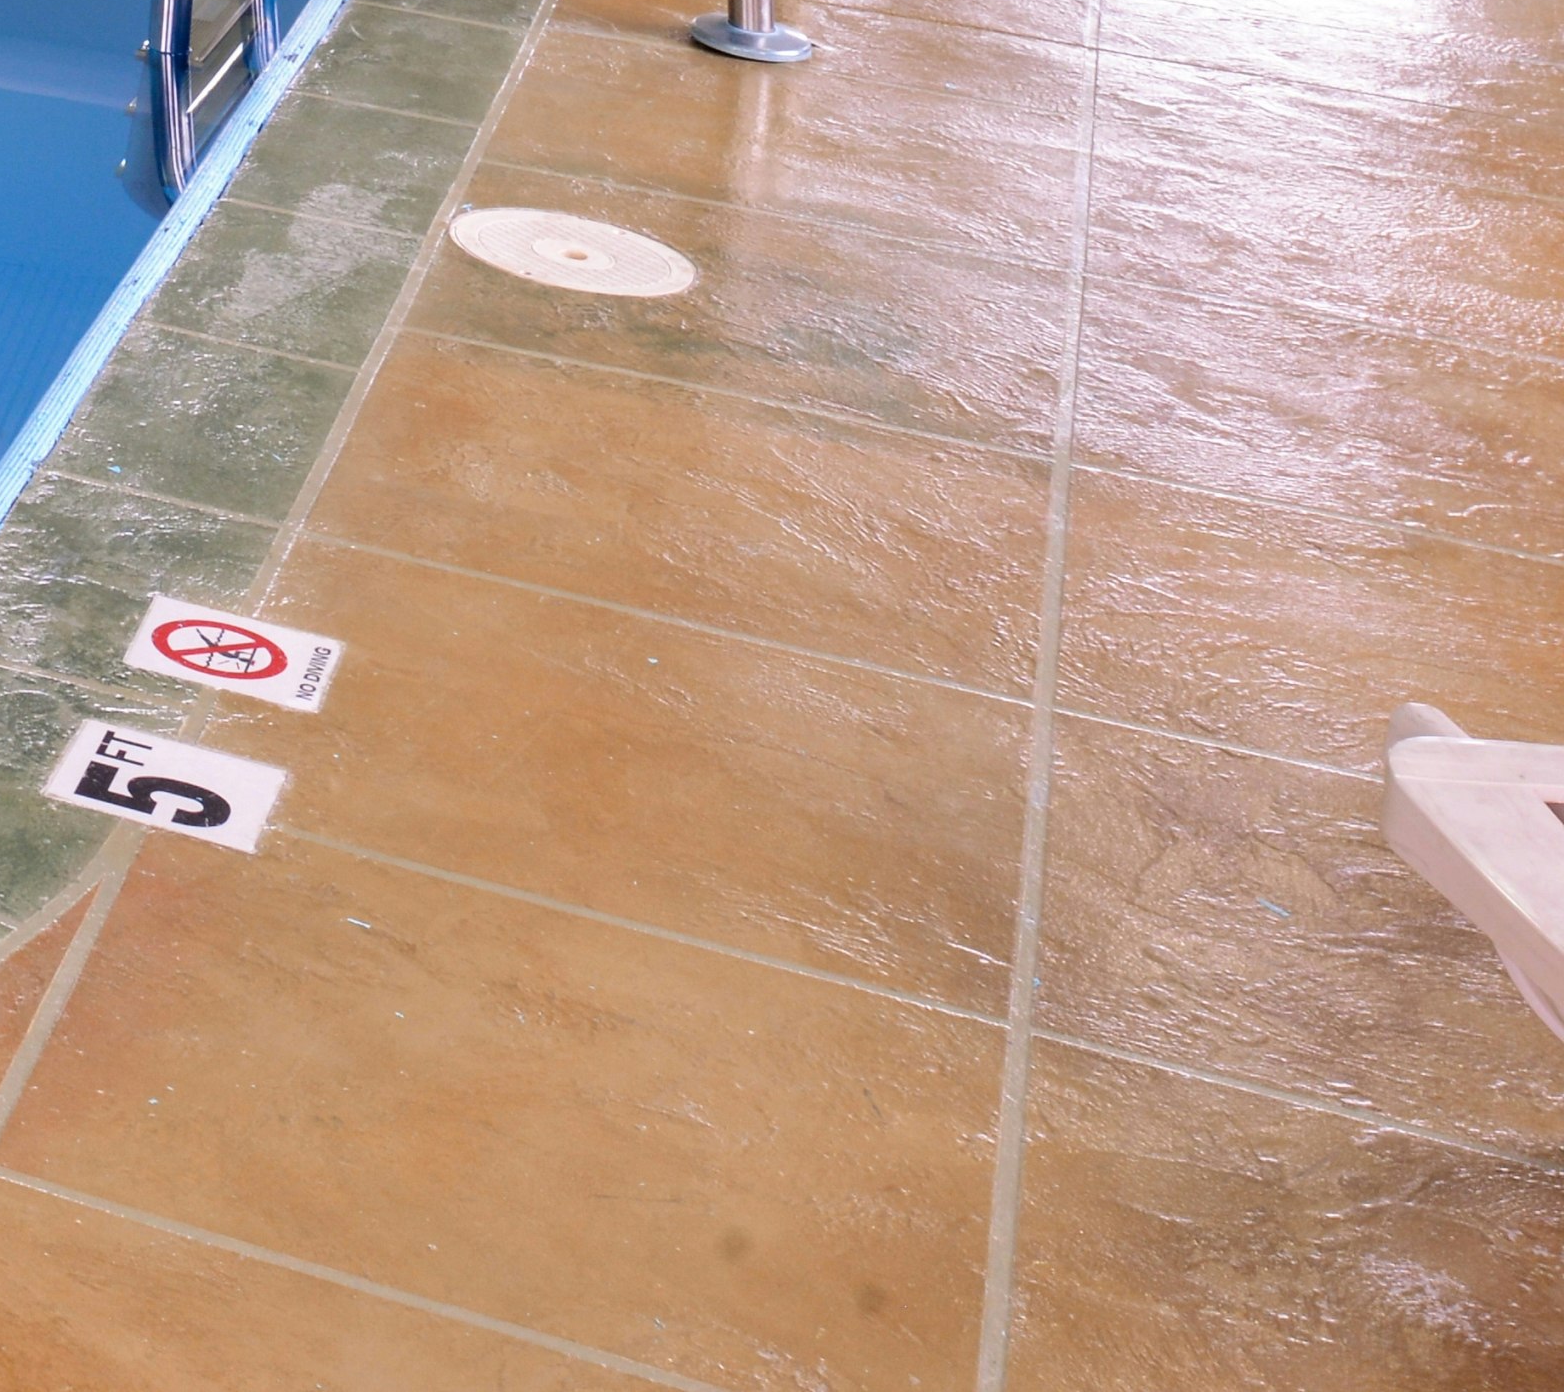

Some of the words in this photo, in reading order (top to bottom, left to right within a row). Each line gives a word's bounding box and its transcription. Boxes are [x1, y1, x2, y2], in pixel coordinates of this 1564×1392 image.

[303, 646, 332, 683] DIVING
[296, 683, 317, 701] NO
[96, 730, 152, 766] FT
[74, 760, 231, 828] 5
